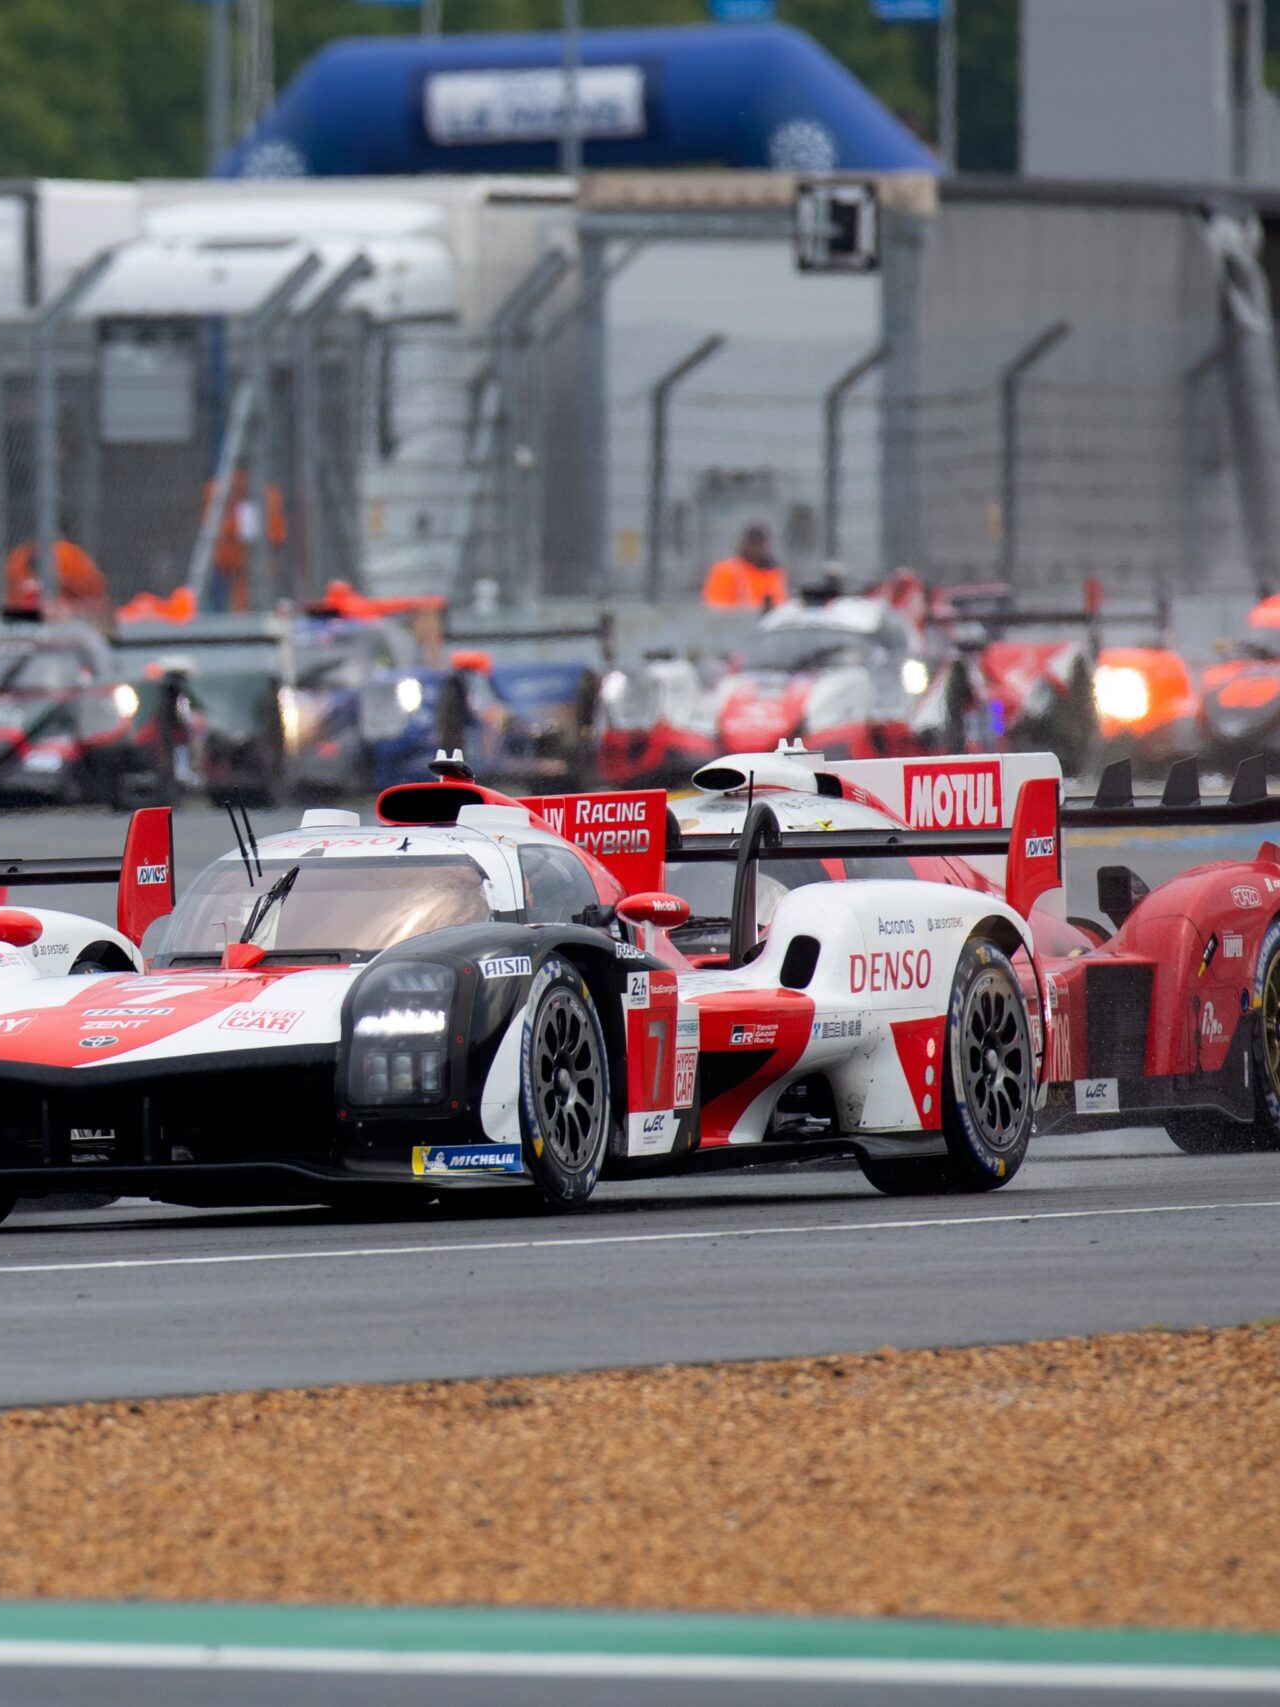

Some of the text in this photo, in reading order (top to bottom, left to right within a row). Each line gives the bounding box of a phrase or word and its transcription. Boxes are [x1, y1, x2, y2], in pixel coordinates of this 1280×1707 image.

[909, 772, 998, 827] MOTUL
[574, 829, 650, 855] HYBRID
[652, 901, 677, 912] Mobil
[878, 916, 915, 935] Acronis
[48, 944, 69, 955] SYSTEMS
[485, 959, 530, 976] AISIN
[849, 948, 932, 993] DENSO
[117, 985, 209, 1006] 7
[235, 1009, 296, 1018] HYPER
[80, 1020, 149, 1030] ZENT
[227, 1017, 289, 1031] CAR
[731, 1032, 752, 1044] GR
[648, 1020, 667, 1102] 7
[676, 1053, 696, 1071] HYPER
[675, 1072, 694, 1102] CAR
[1085, 1083, 1108, 1098] WEC
[644, 1115, 666, 1133] WEC
[450, 1153, 515, 1166] MICHELIN
